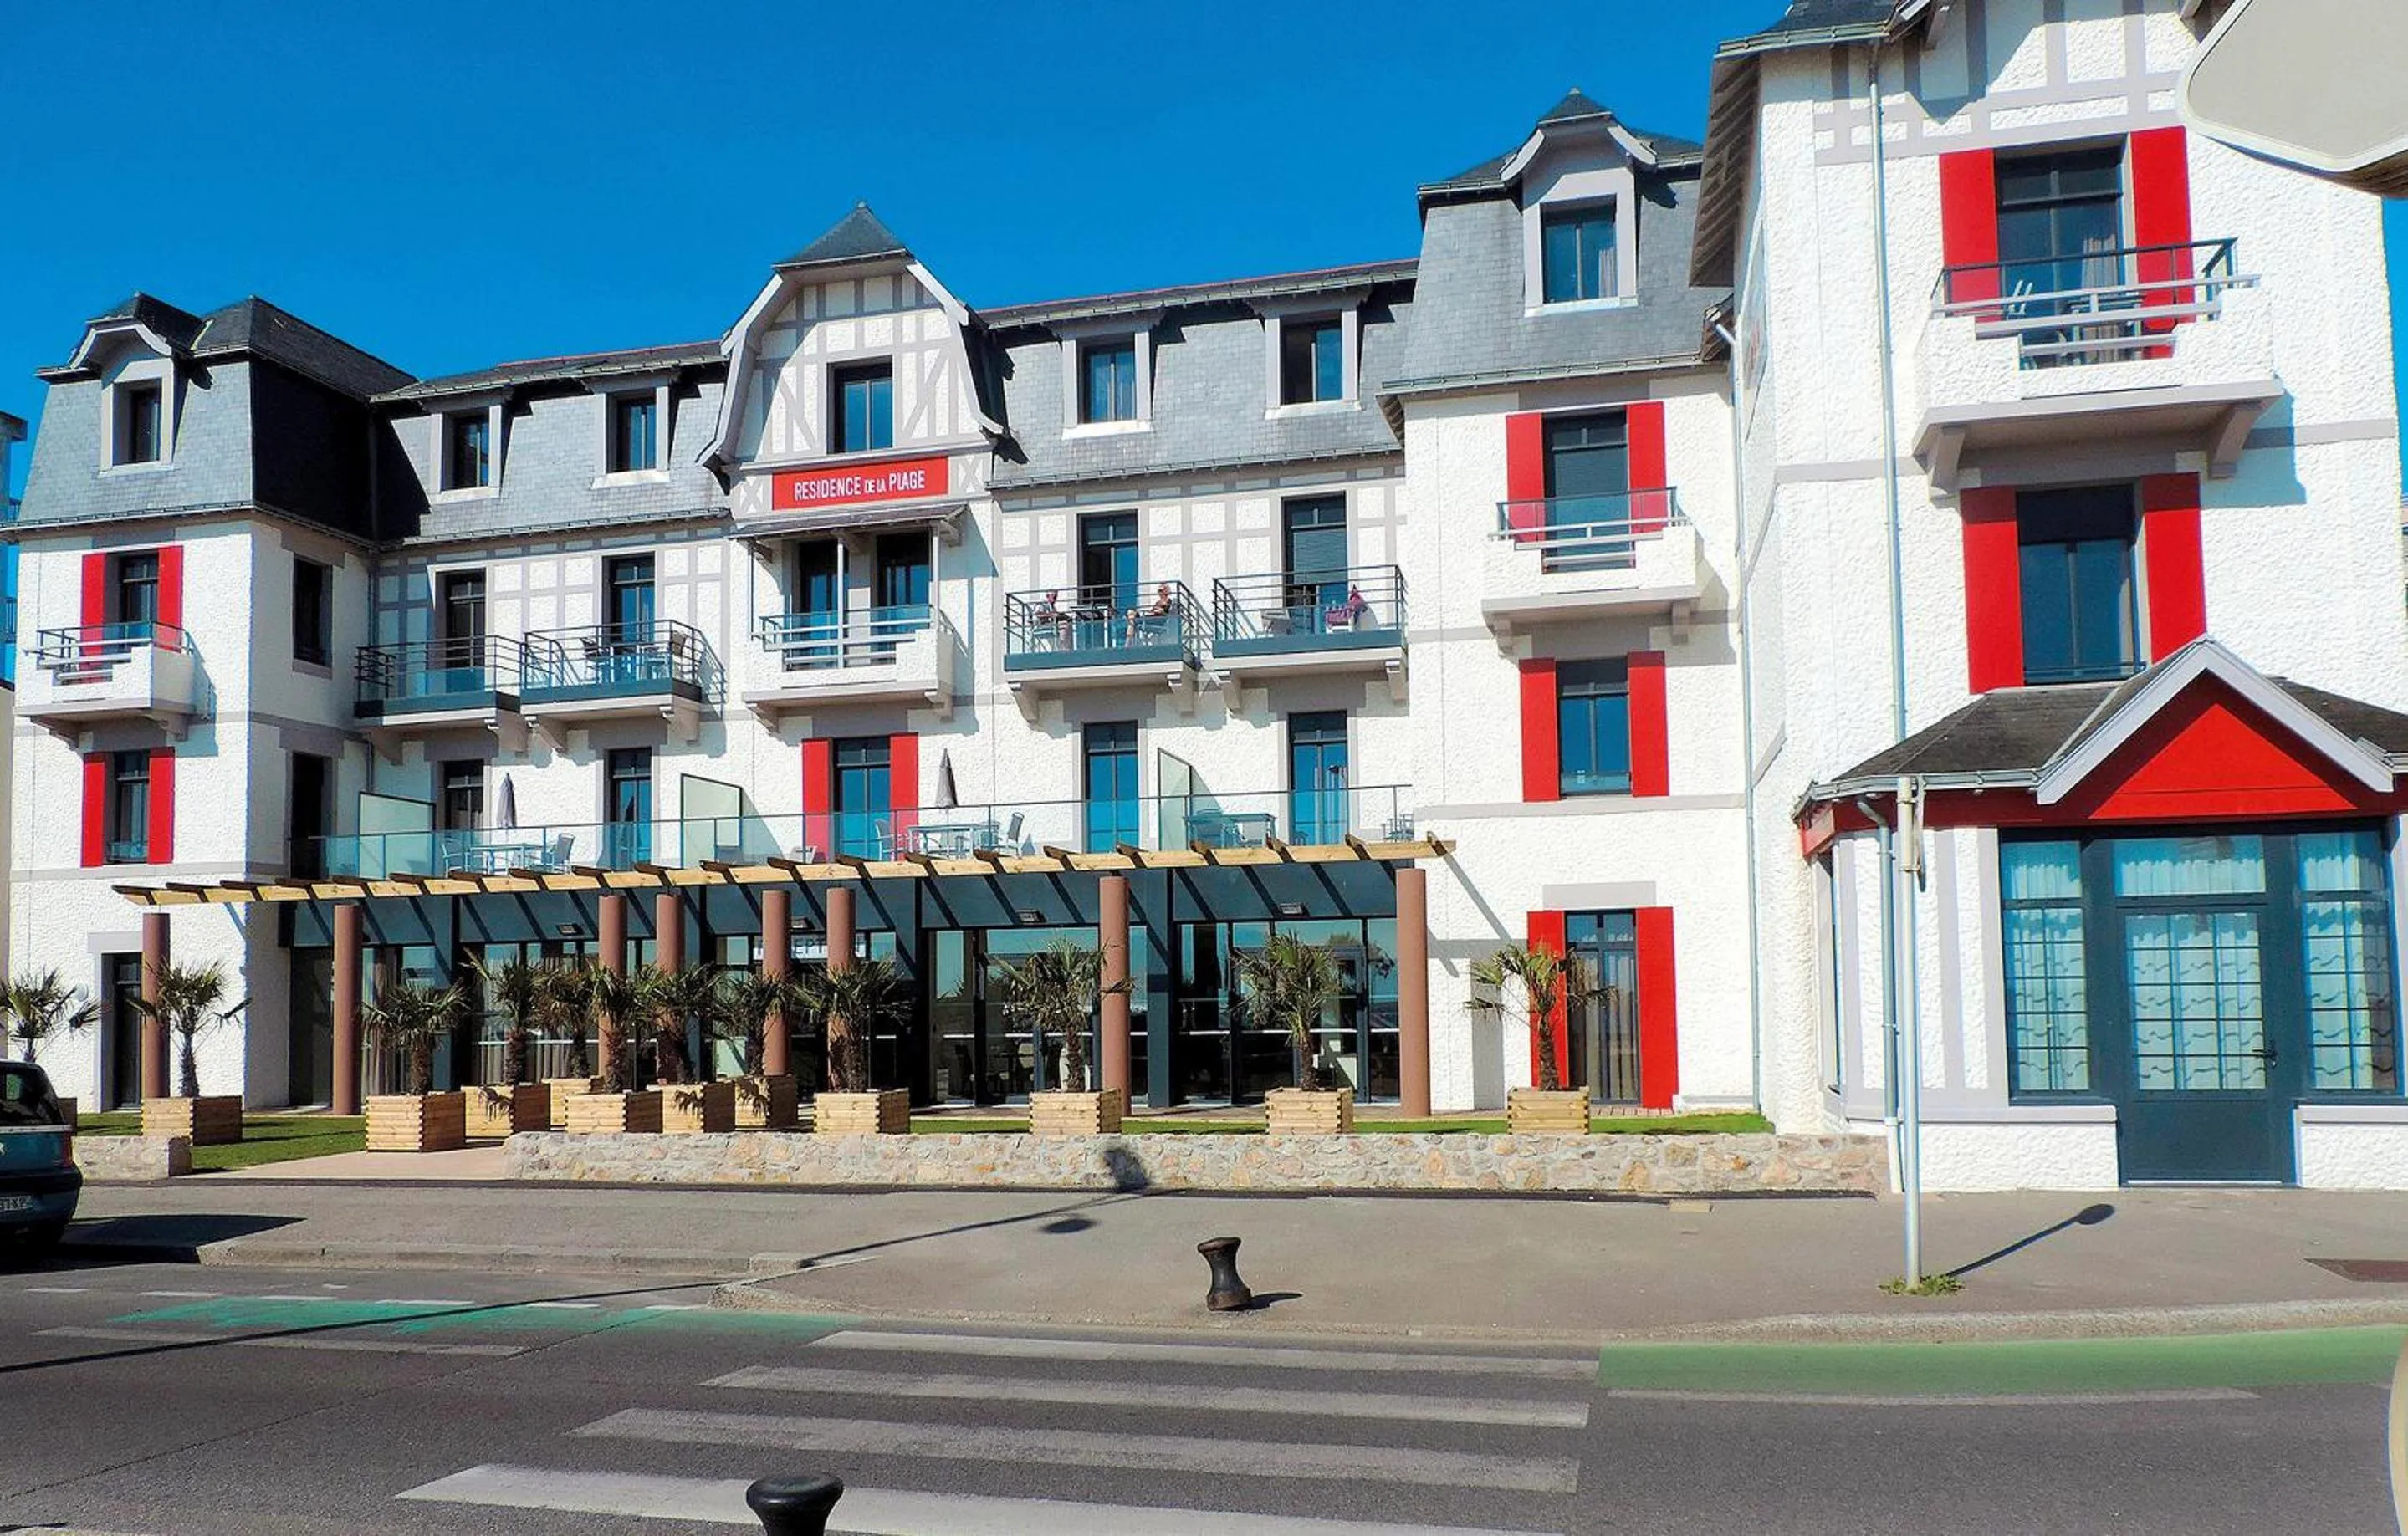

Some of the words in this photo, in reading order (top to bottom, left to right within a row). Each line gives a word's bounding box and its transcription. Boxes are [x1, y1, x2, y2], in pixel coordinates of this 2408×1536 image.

[794, 476, 861, 501] RESIDENCE
[864, 479, 876, 493] DE
[876, 477, 887, 493] LA
[888, 469, 926, 492] PLAGE
